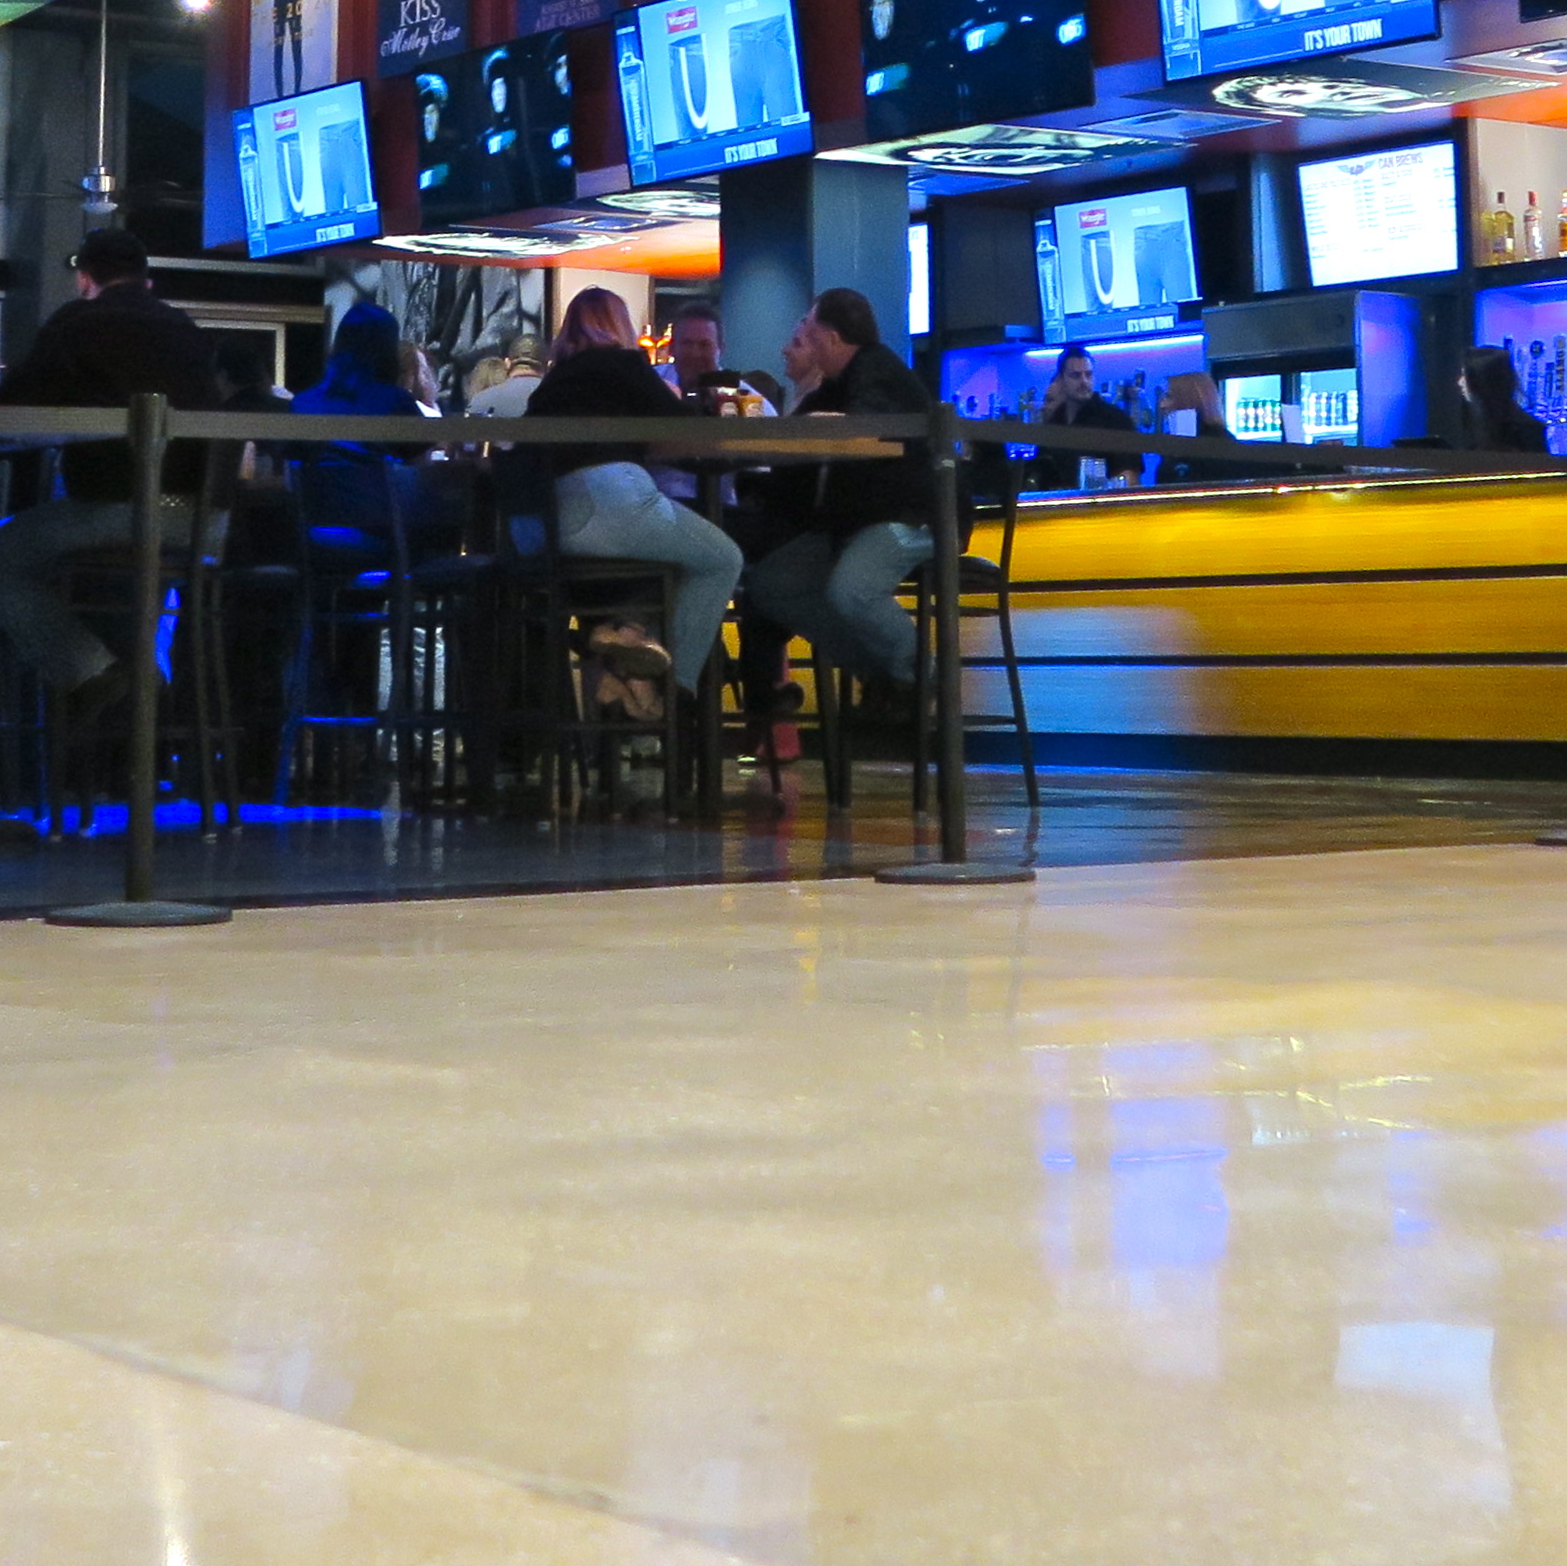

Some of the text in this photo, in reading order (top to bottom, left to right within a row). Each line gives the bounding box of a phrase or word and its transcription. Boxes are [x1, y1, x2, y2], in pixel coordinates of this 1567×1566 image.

[1303, 17, 1383, 52] IT'S YOUR TOWN
